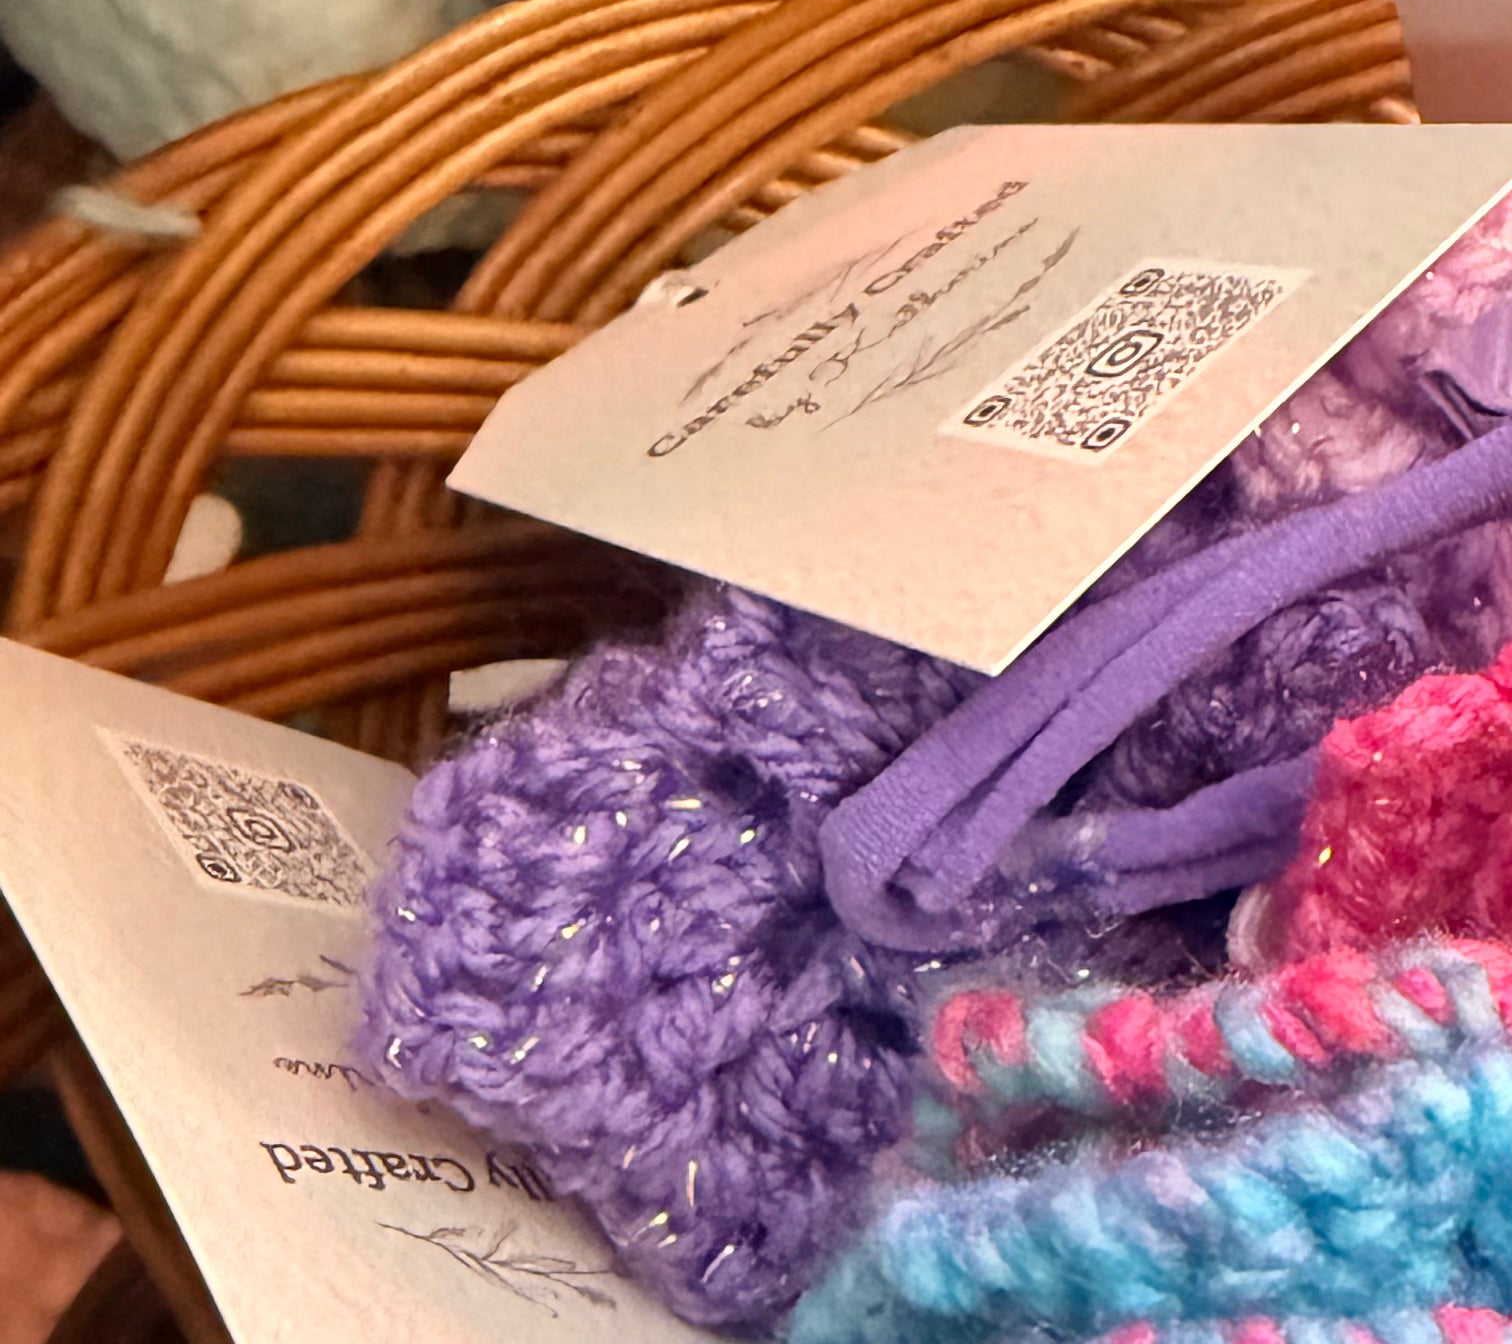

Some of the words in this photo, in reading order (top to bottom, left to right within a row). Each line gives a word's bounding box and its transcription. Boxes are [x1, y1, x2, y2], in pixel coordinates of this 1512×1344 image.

[646, 302, 860, 458] Carefully
[863, 181, 1030, 296] Crafted
[259, 1139, 475, 1192] Crafted
